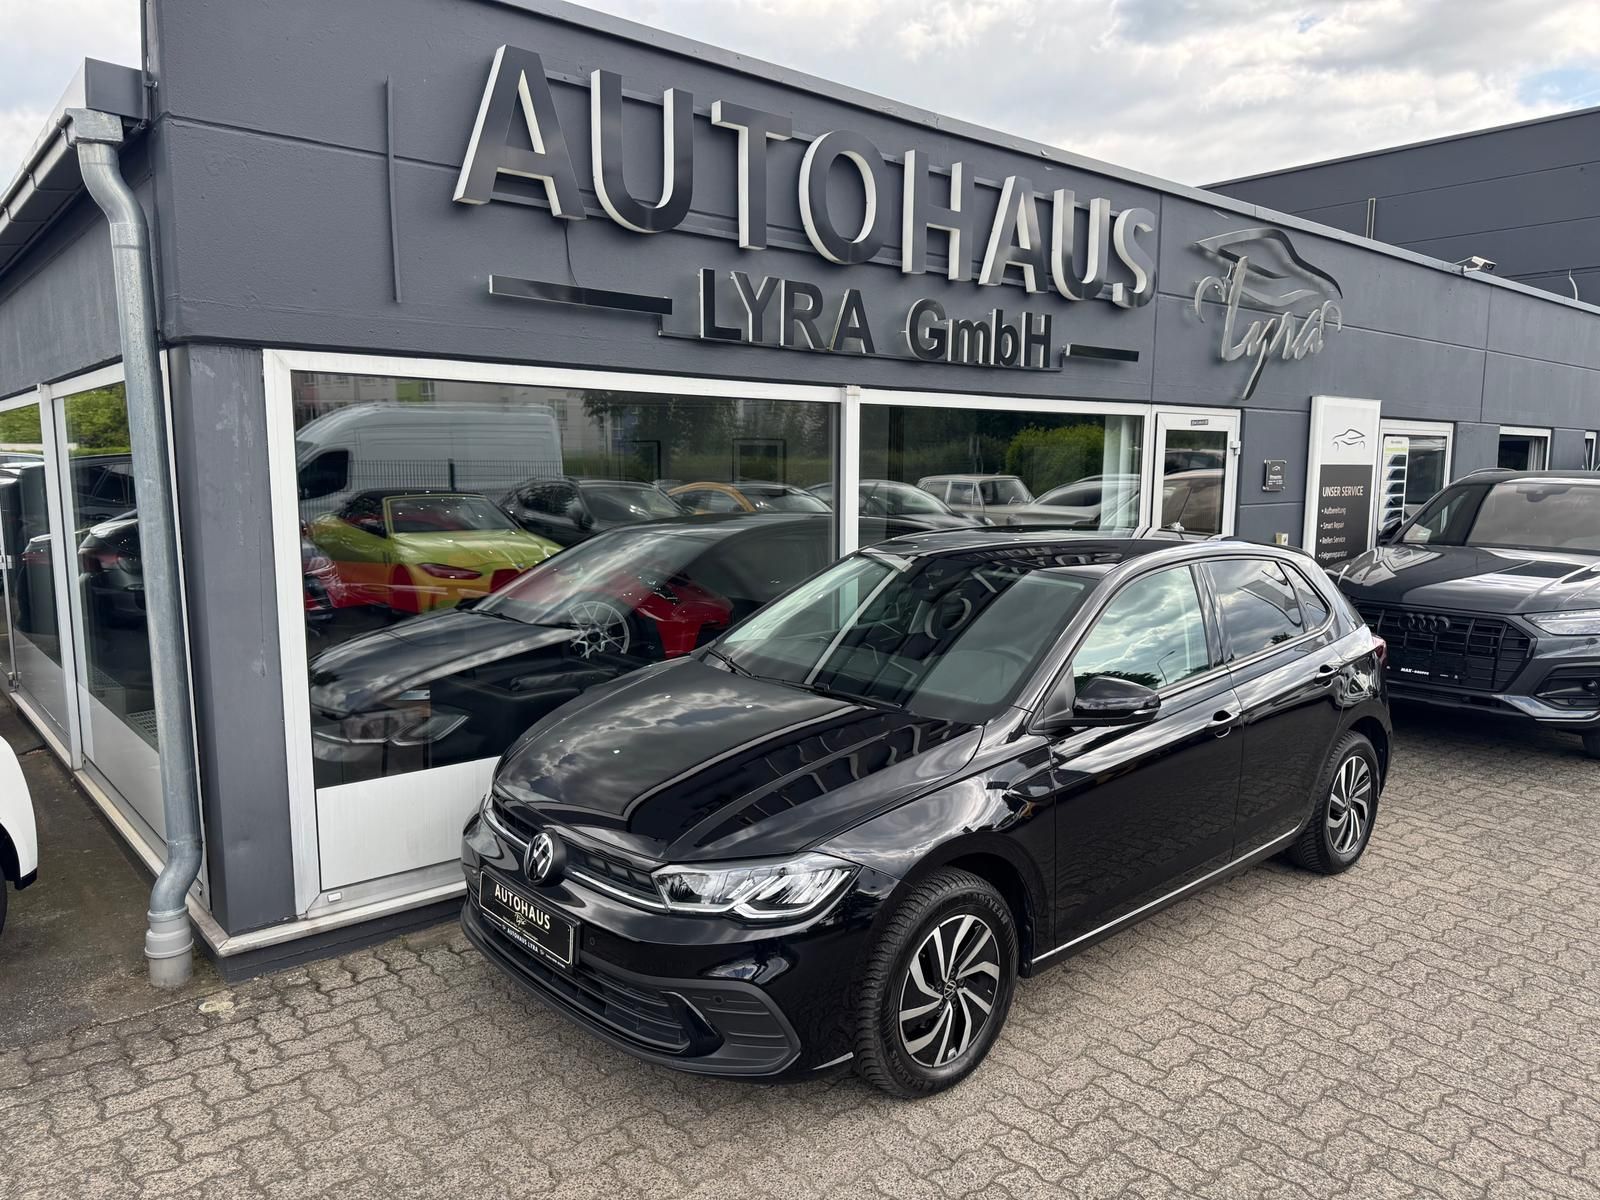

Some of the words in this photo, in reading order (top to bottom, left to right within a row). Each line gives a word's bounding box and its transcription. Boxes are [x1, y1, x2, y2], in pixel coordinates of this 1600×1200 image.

[454, 44, 1157, 310] AUTOHAUS
[699, 267, 876, 355] LYRA
[904, 297, 1053, 370] GmbH
[1322, 486, 1340, 497] UNSER
[1341, 486, 1363, 496] SERVICE
[494, 884, 550, 930] AUTOHAUS
